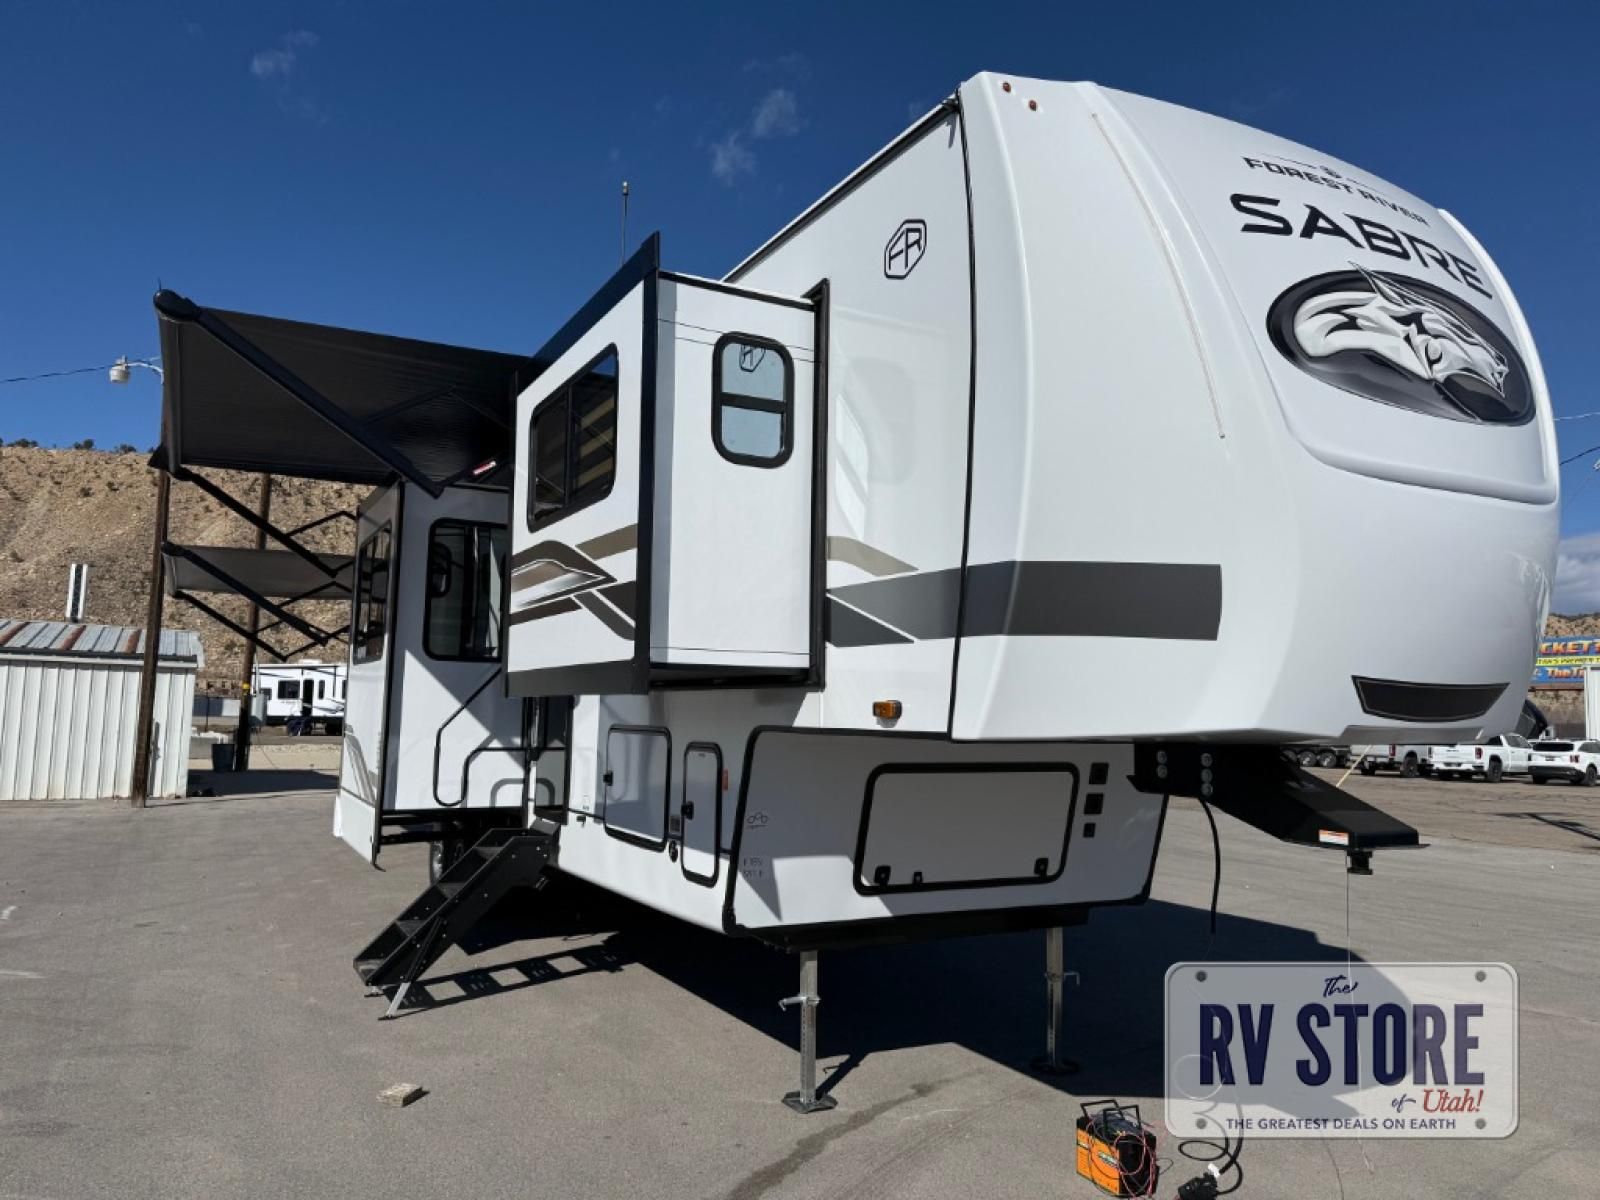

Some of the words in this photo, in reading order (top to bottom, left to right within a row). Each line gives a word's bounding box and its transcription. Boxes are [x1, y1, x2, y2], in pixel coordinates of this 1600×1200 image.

[1242, 156, 1353, 194] FOREST
[1357, 188, 1430, 227] RIVER
[1230, 193, 1492, 300] SABRE
